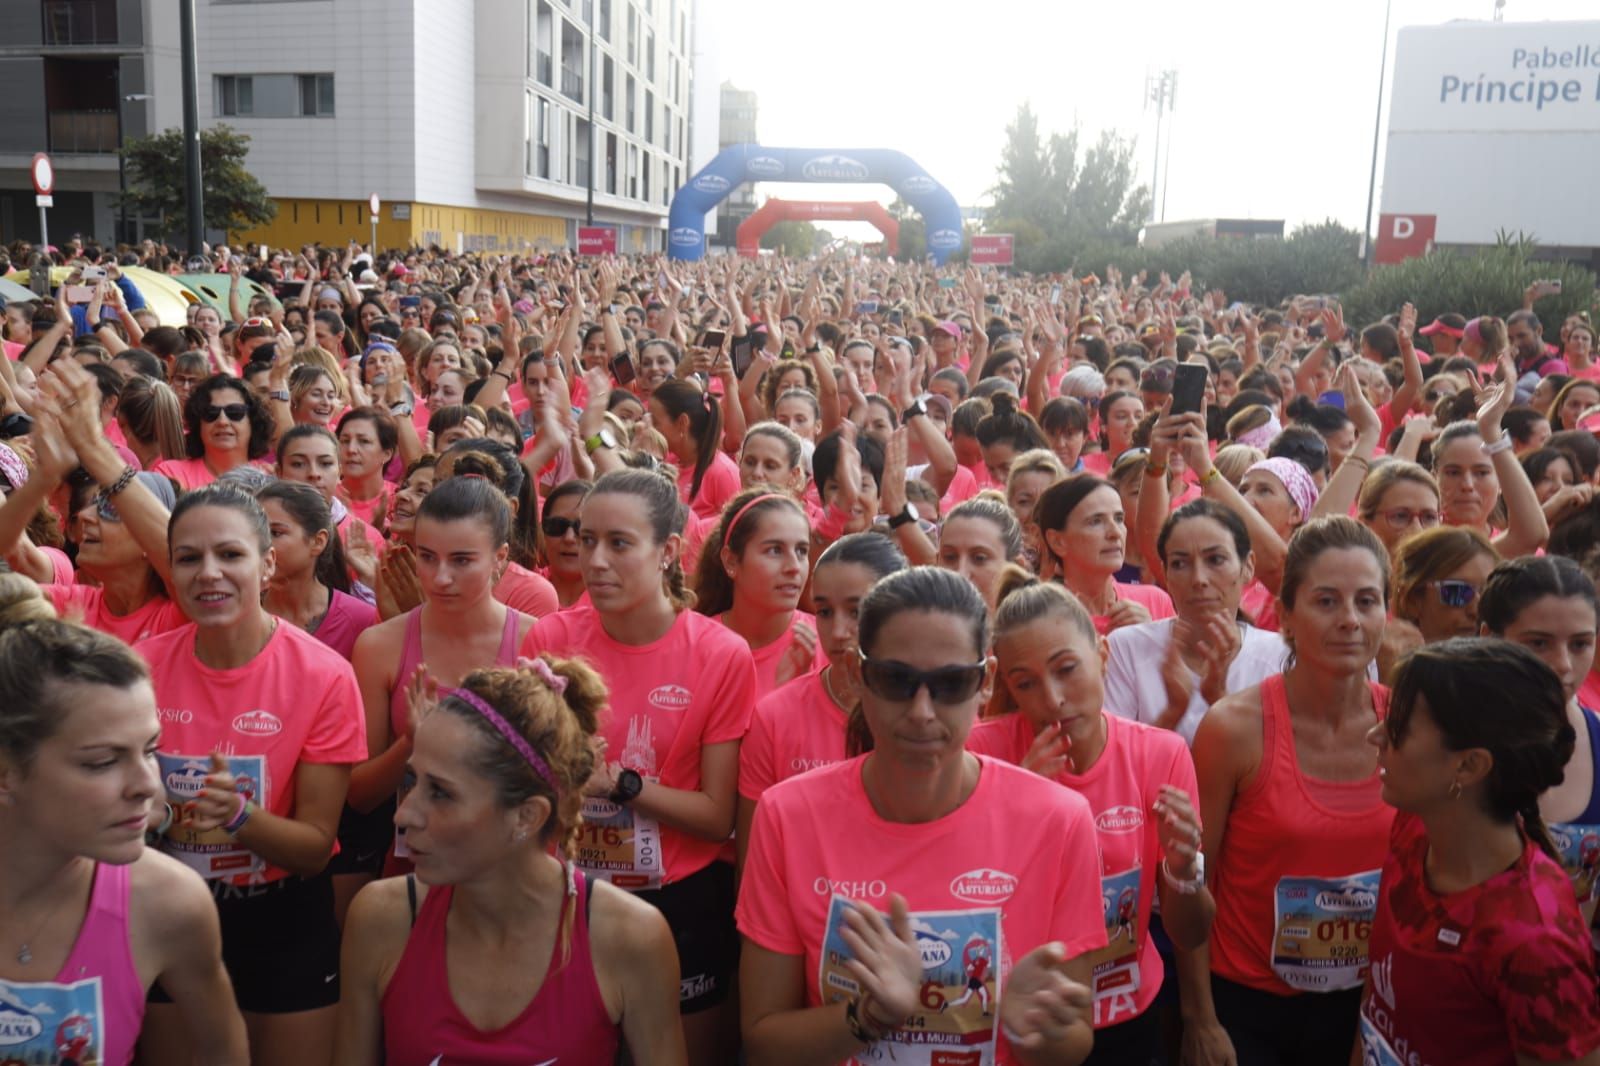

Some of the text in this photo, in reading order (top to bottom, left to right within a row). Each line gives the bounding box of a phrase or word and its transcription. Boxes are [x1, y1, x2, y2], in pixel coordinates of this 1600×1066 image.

[1440, 73, 1582, 111] Príncipe
[1393, 217, 1415, 239] D
[157, 708, 193, 723] YSHO
[814, 877, 887, 898] OYSHO
[957, 881, 1014, 896] ASTURIANA
